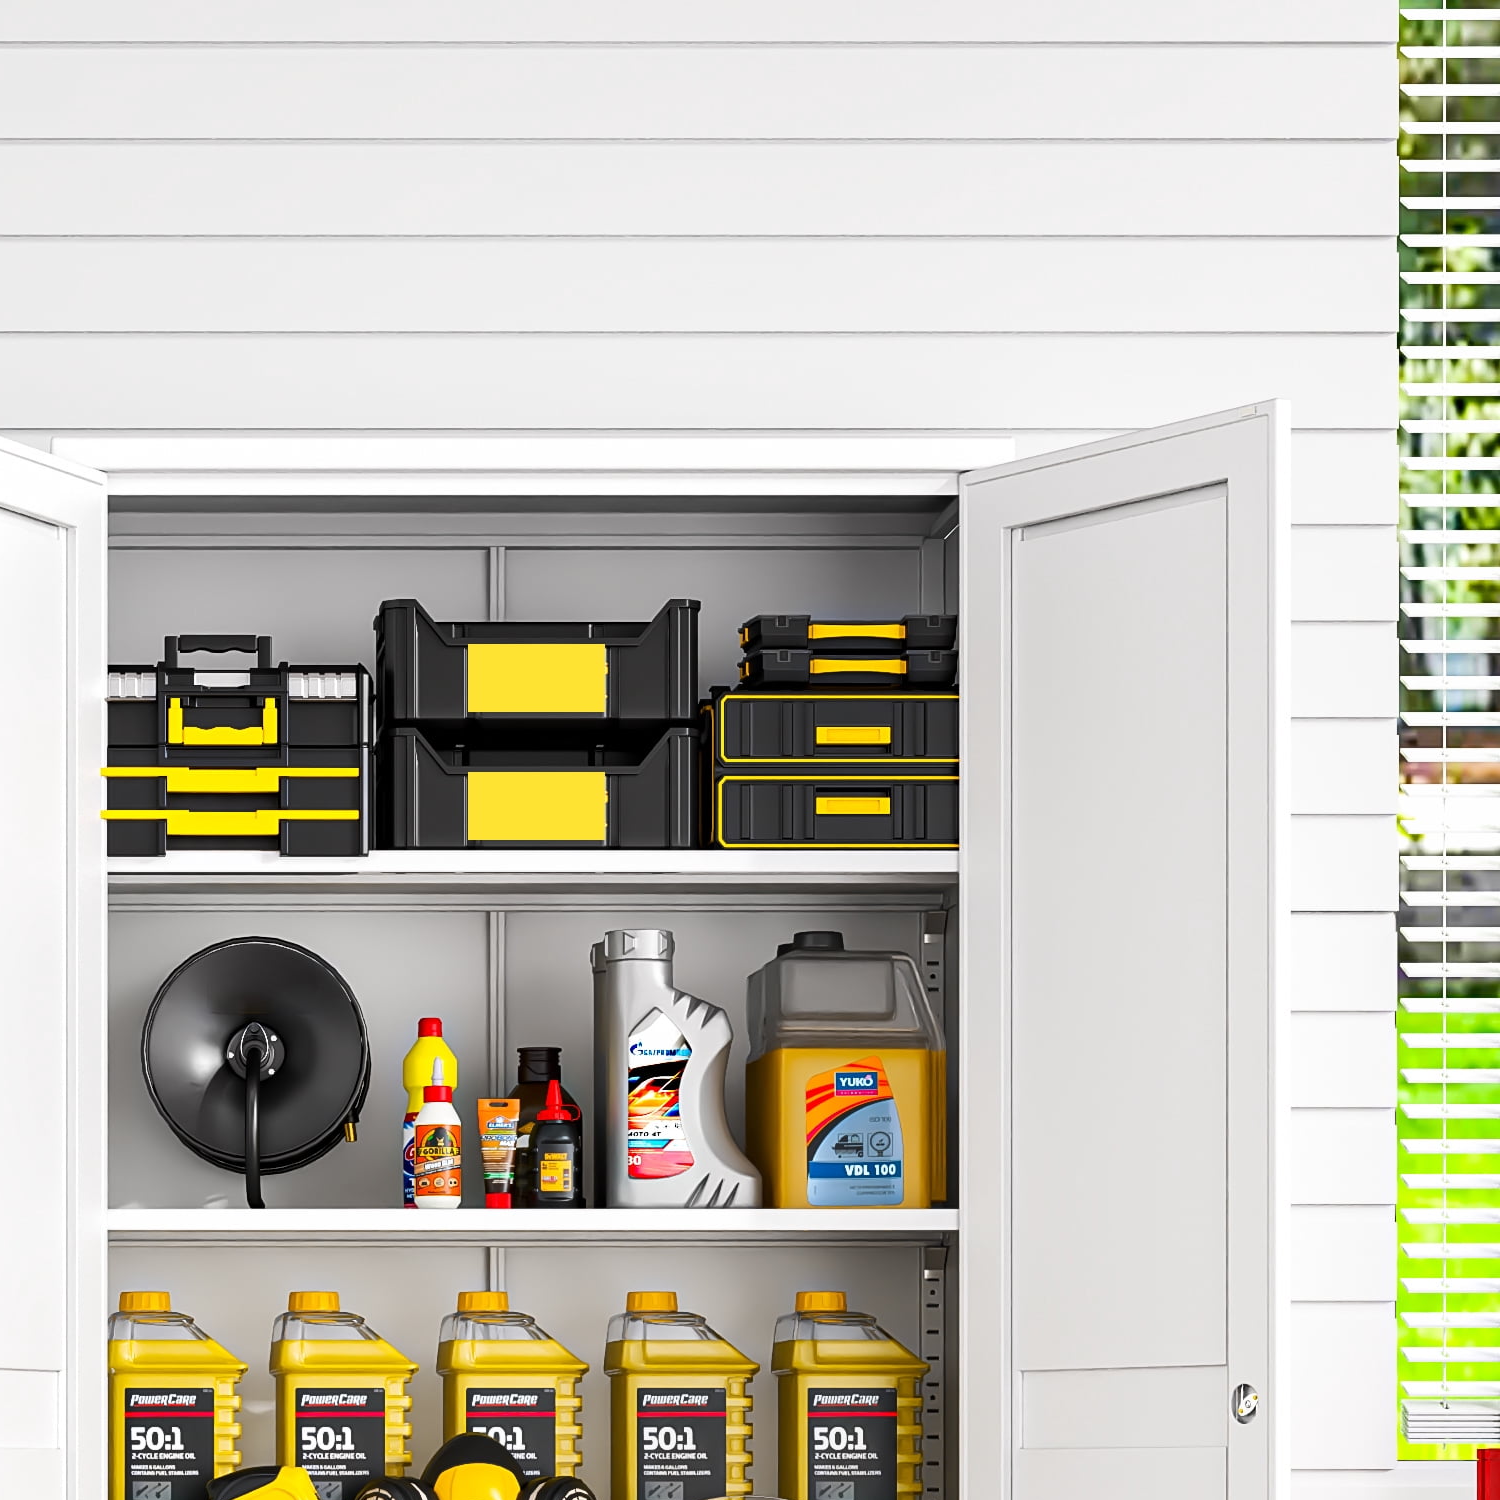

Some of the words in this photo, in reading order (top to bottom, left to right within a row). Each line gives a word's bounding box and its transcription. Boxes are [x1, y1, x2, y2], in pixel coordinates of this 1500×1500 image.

[840, 1077, 874, 1087] YUKO
[423, 1147, 454, 1155] GORILLA
[845, 1165, 870, 1176] VDL
[874, 1164, 896, 1176] 100
[131, 1426, 184, 1451] 50:1
[301, 1426, 355, 1451] 50:1
[473, 1426, 526, 1451] 0:1
[643, 1426, 696, 1451] 50:1
[814, 1426, 867, 1451] 50:1
[131, 1452, 158, 1460] 2-CYCLE
[302, 1452, 329, 1460] 2-CYCLE
[644, 1452, 670, 1460] 2-CYCLE
[814, 1452, 841, 1460] 2-CYCLE
